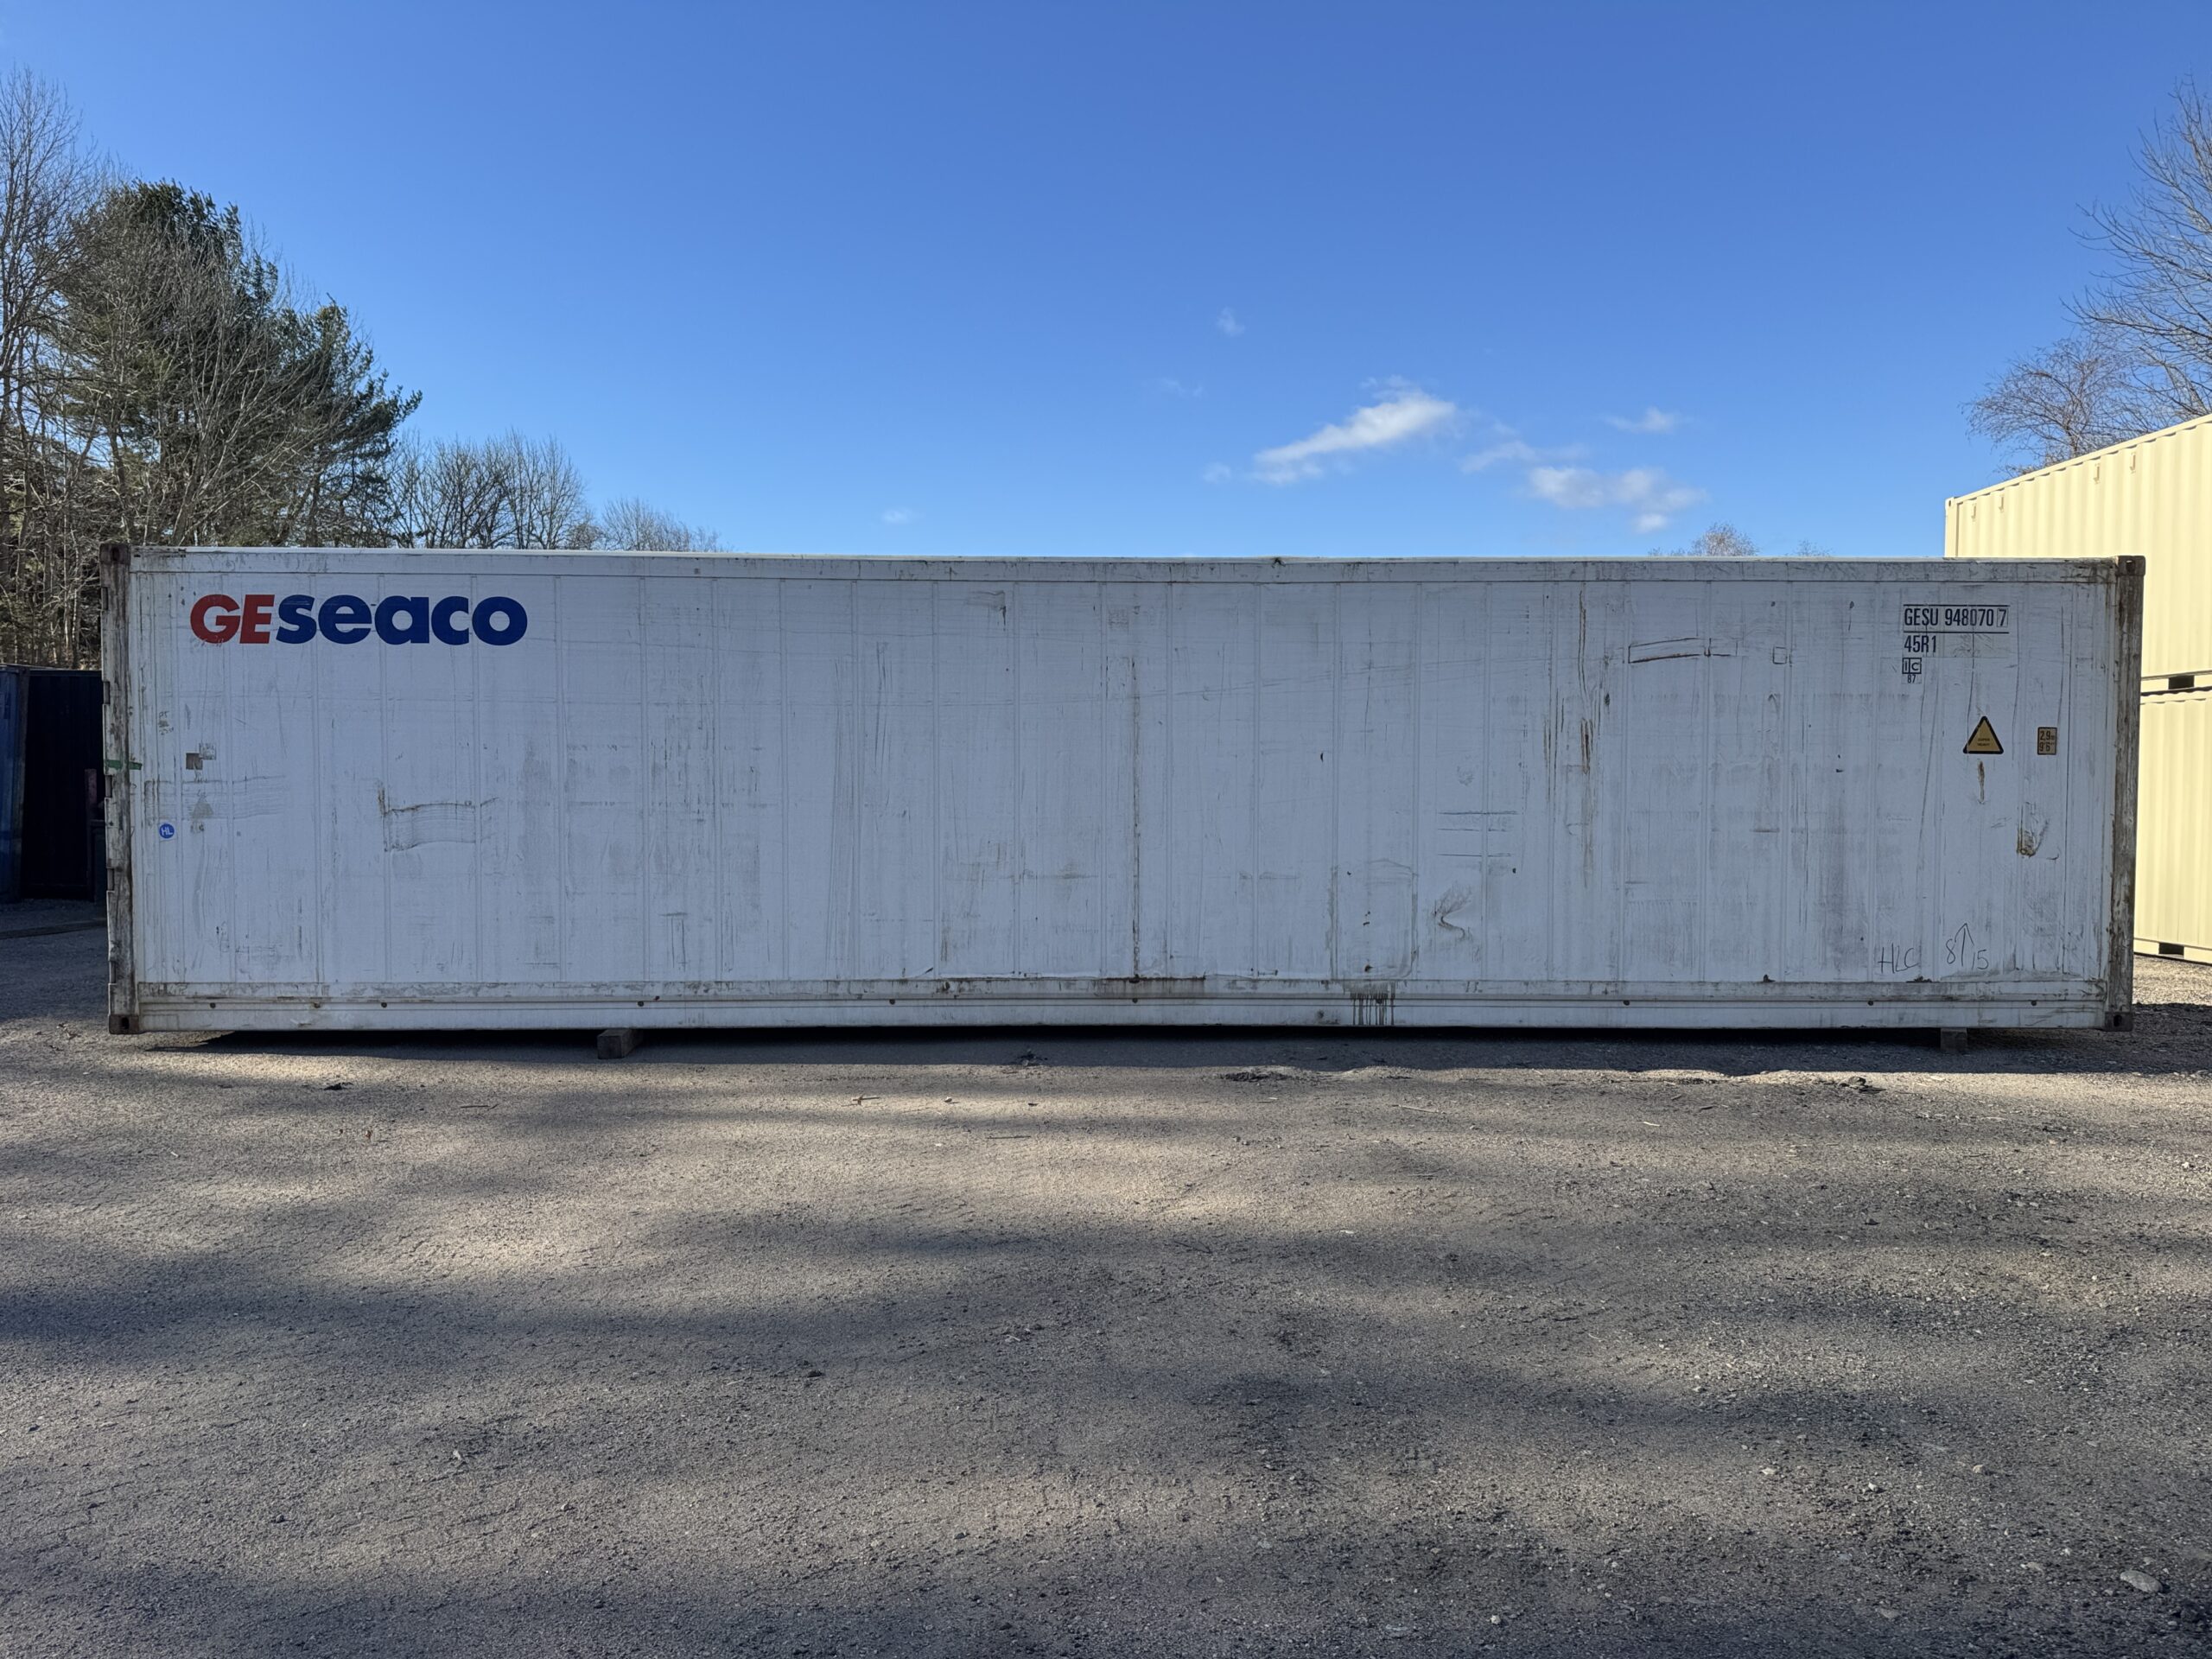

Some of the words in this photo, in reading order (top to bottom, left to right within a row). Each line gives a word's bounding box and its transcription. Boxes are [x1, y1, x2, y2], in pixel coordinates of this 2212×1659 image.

[189, 594, 528, 645] GEseaco
[1904, 607, 1939, 626] GESU
[1944, 608, 1994, 626] 948070
[1904, 635, 1936, 653] 45R1
[161, 827, 174, 836] HL
